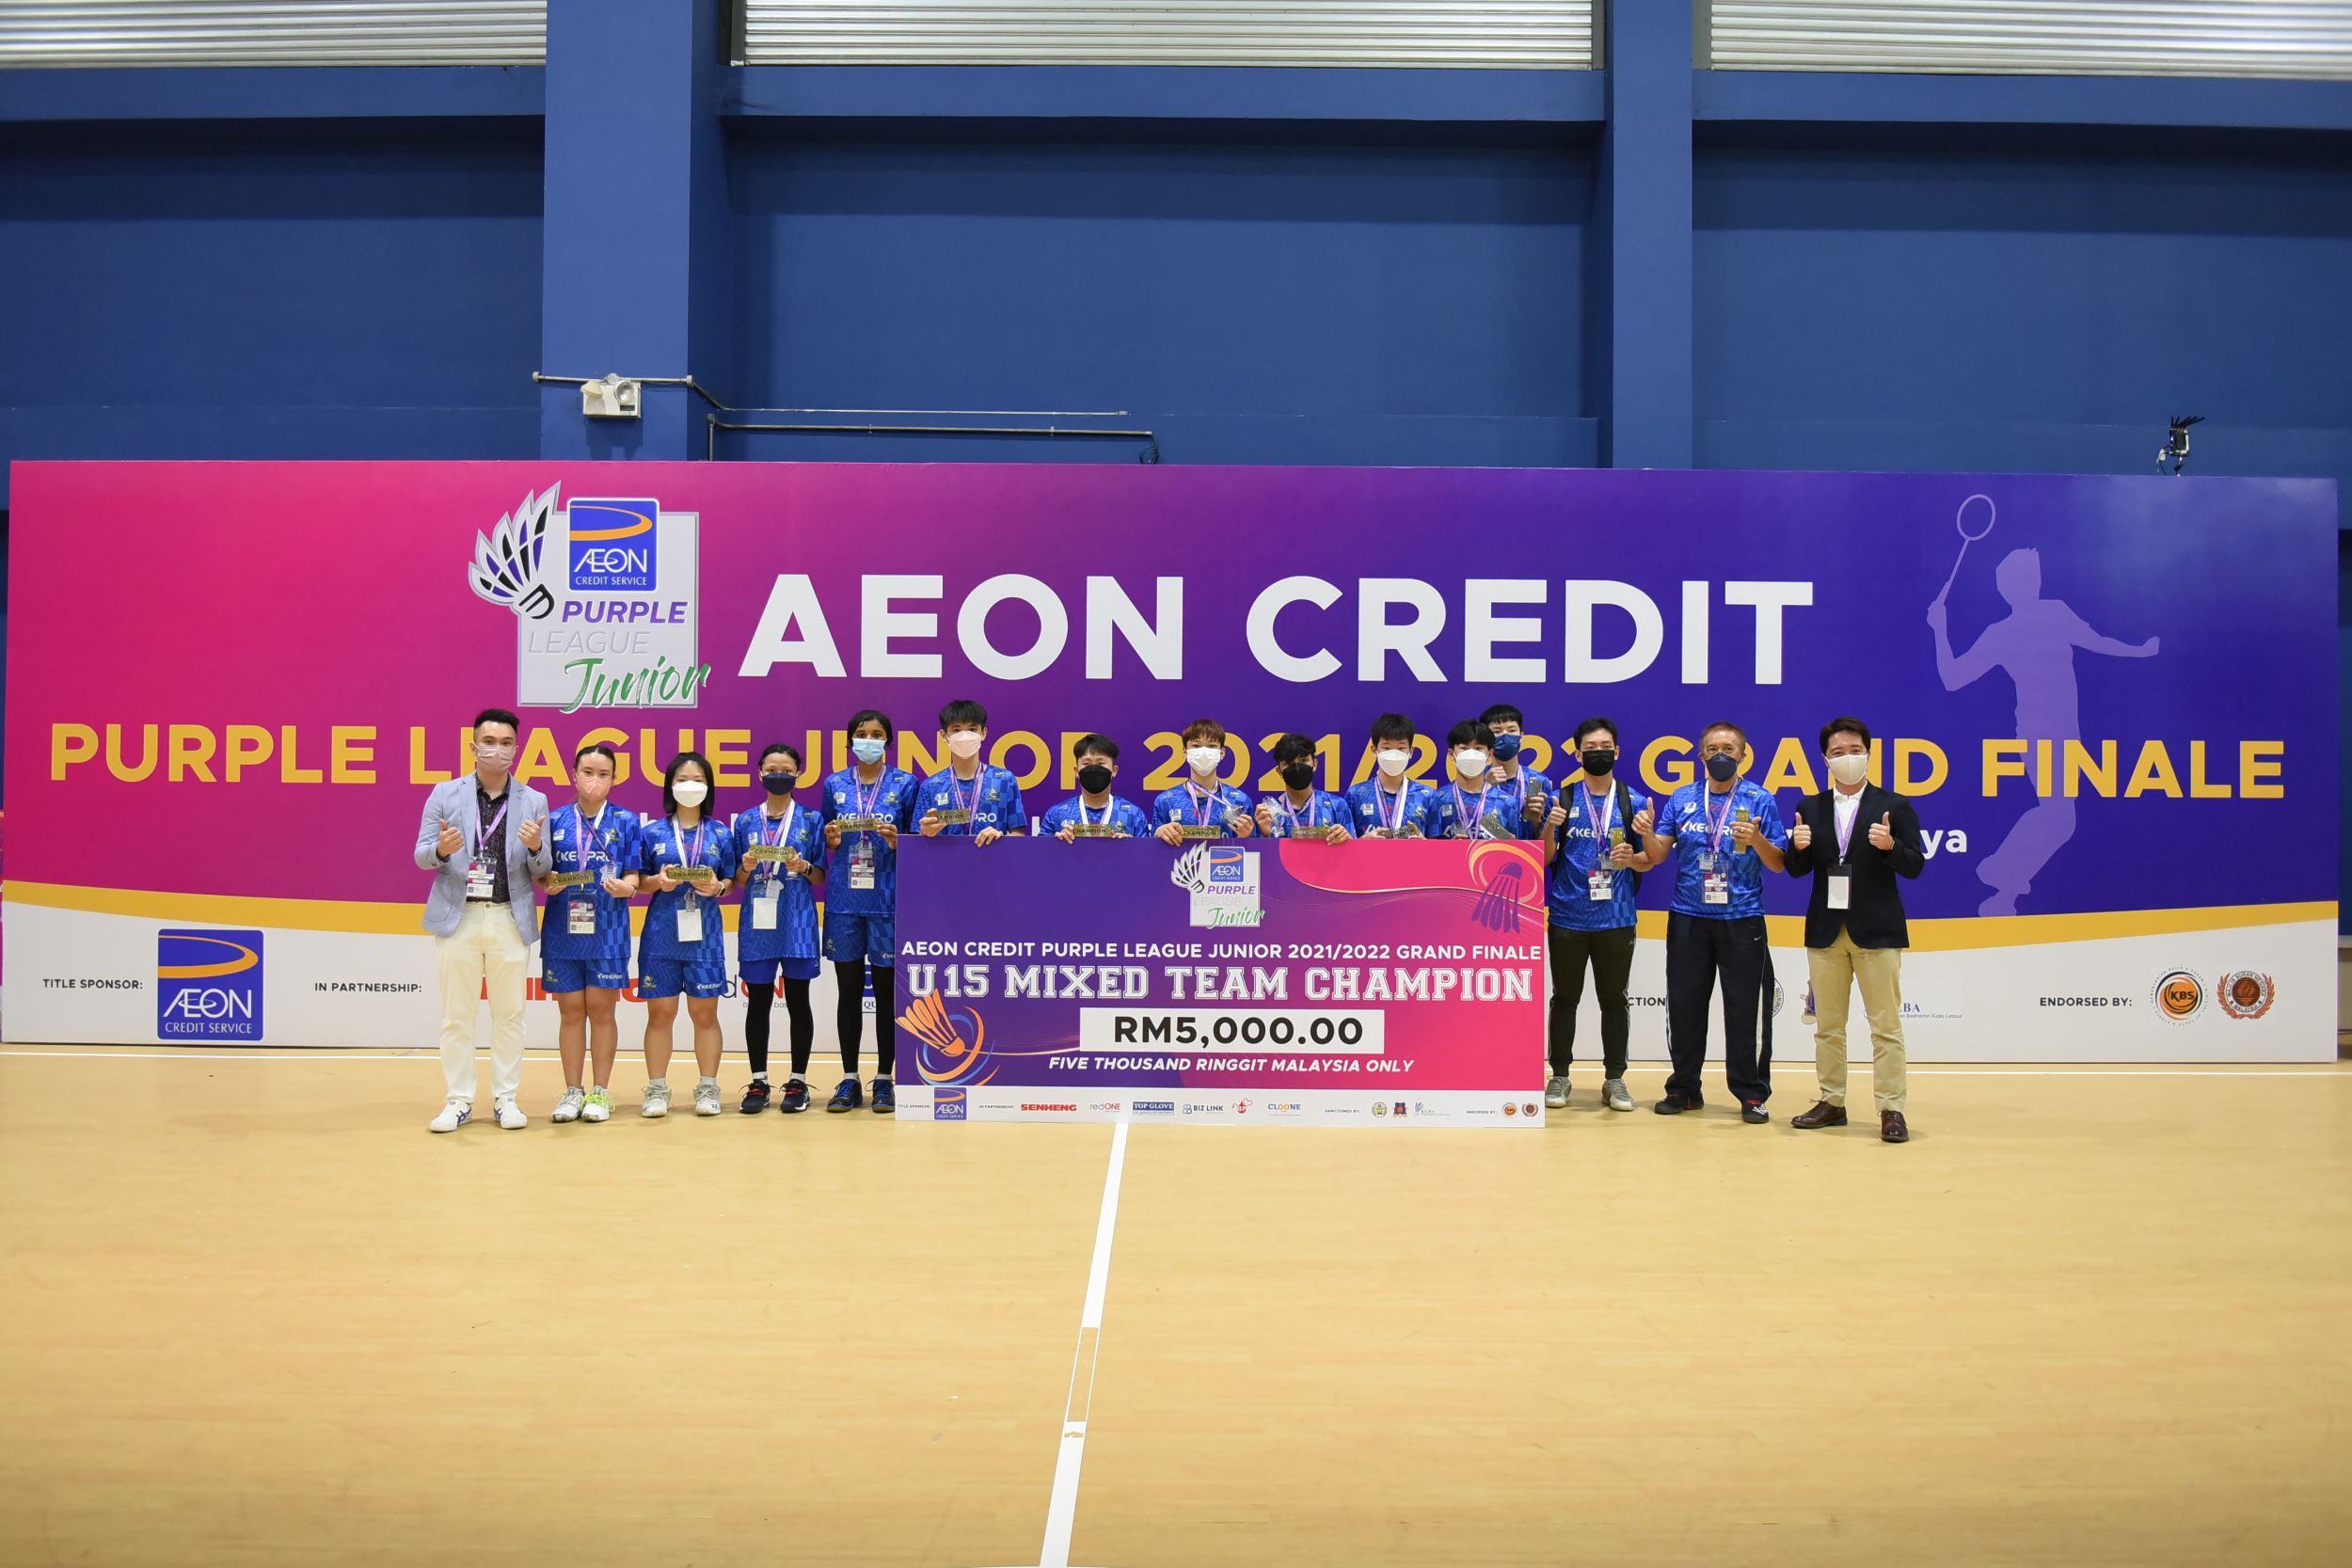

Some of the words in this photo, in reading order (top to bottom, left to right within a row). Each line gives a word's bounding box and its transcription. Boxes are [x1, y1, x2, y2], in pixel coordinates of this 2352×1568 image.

[575, 577, 608, 585] CREDIT
[612, 577, 647, 586] SERVICE
[562, 600, 689, 624] PURPLE
[738, 573, 1184, 681] AEON
[1246, 575, 1814, 685] CREDIT
[528, 630, 652, 655] LEAGUE
[559, 656, 712, 714] Junior
[51, 723, 377, 784] PURPLE
[1982, 738, 2284, 799] FINALE
[1207, 885, 1256, 895] PURPLE
[1206, 907, 1265, 929] Junior
[901, 941, 958, 957] AEON
[964, 942, 1035, 958] CREDIT
[1041, 942, 1118, 958] PURPLE
[1123, 942, 1202, 958] LEAGUE
[1209, 943, 1281, 958] JUNIOR
[1288, 943, 1391, 959] 2021/2022
[1396, 944, 1466, 959] GRAND
[1472, 945, 1542, 960] FINALE
[42, 978, 76, 989] TITLE
[80, 979, 143, 990] SPONSOR:
[315, 982, 327, 992] IN
[331, 983, 422, 993] PARTNERSHIP:
[907, 964, 990, 999] U15
[1004, 965, 1150, 1000] MIXED
[1165, 965, 1288, 1000] TEAM
[1305, 966, 1533, 1002] CHAMPION
[2040, 997, 2108, 1006] ENDORSED
[2112, 997, 2133, 1006] BY:
[2169, 990, 2195, 1002] KBS
[165, 1022, 205, 1033] CREDIT
[209, 1022, 252, 1034] SERVICE
[1114, 1016, 1363, 1049] RM5,000.00
[1049, 1056, 1088, 1069] FIVE
[1094, 1056, 1191, 1071] THOUSAND
[1197, 1057, 1267, 1072] RINGGIT
[1272, 1058, 1360, 1072] MALAYSIA
[1366, 1059, 1415, 1073] ONLY
[1020, 1103, 1077, 1112] SENHENG
